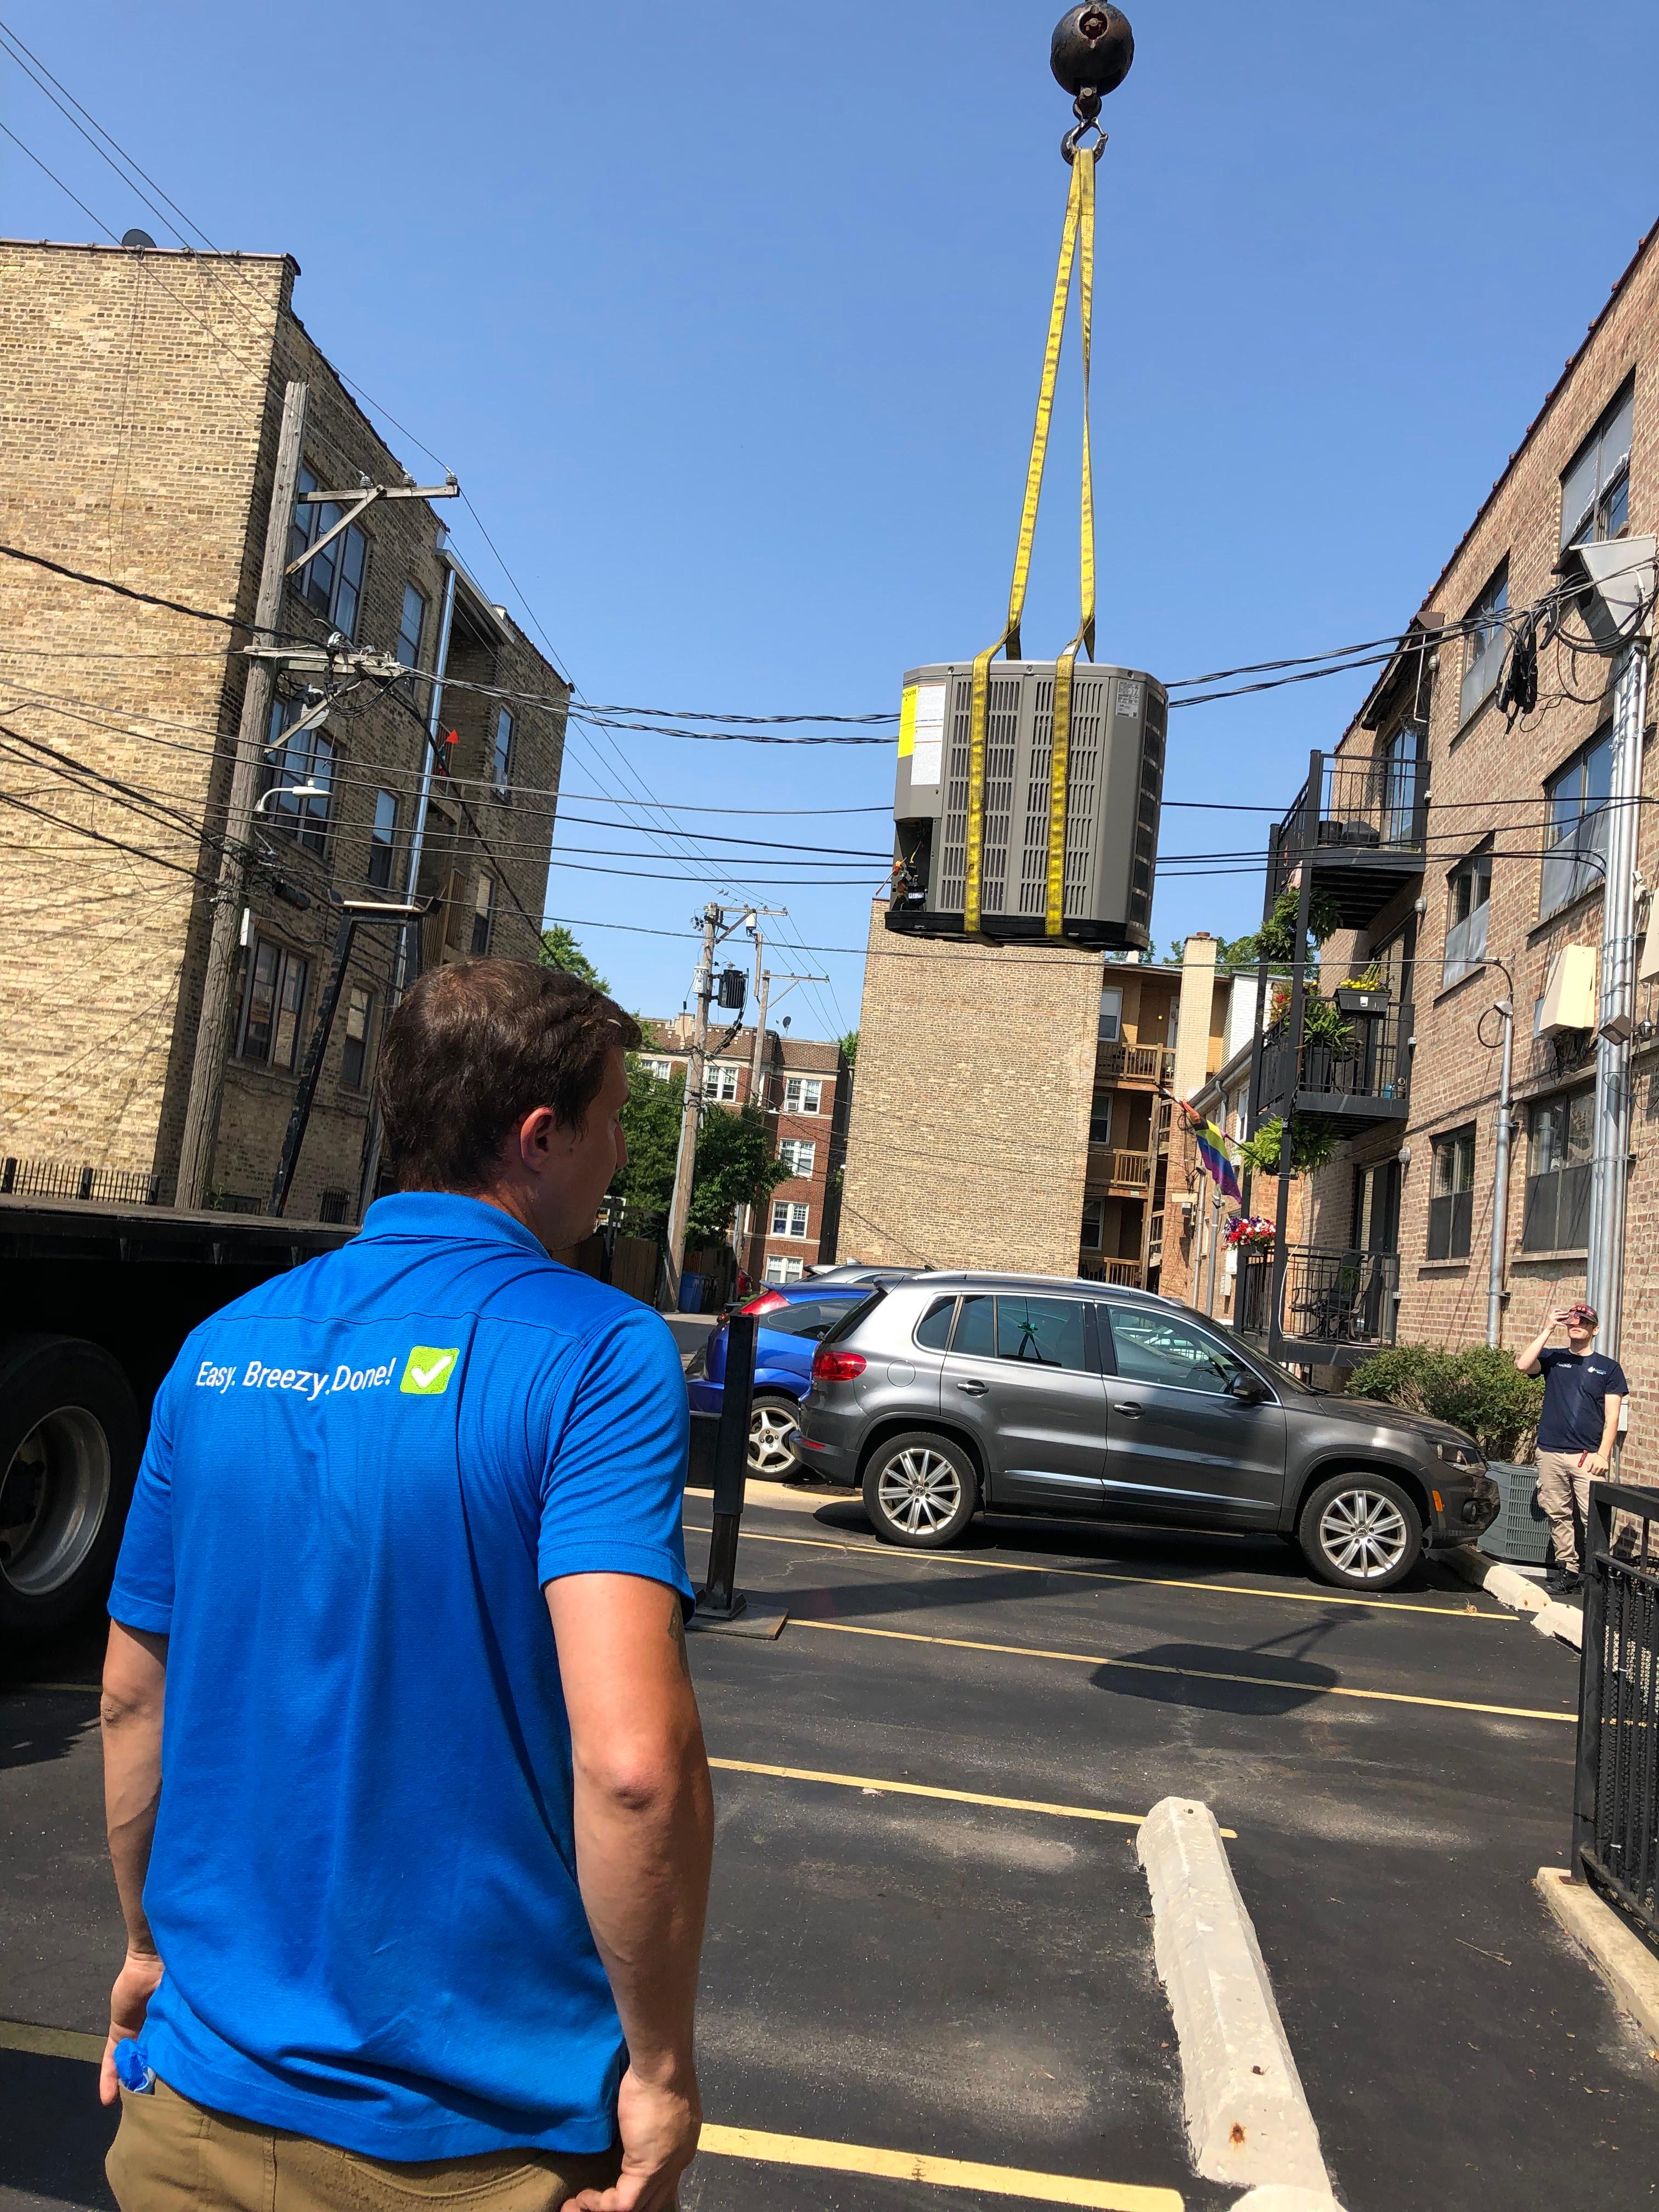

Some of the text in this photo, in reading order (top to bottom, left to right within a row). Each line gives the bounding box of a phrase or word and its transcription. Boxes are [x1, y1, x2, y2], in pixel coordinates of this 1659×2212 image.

[196, 1357, 397, 1401] Easy. Breezy. Done!
